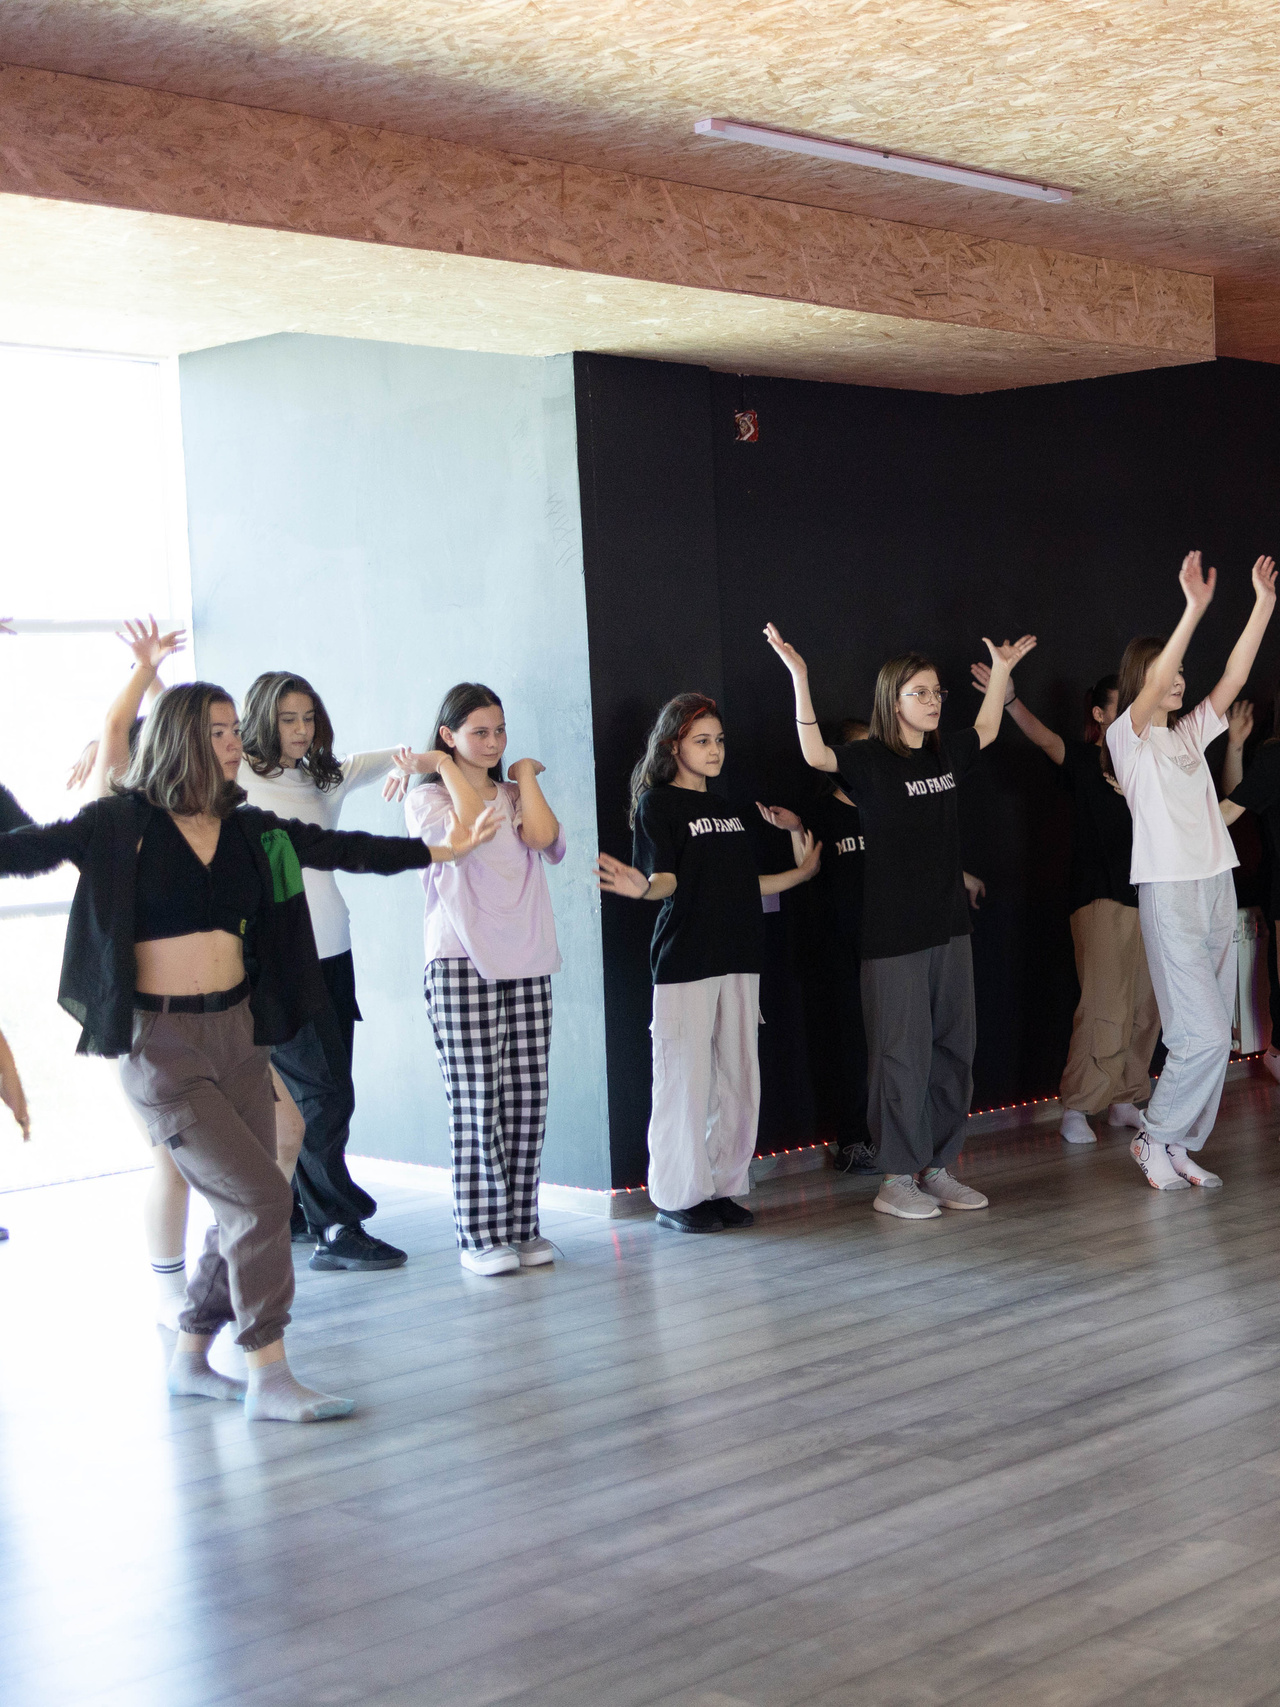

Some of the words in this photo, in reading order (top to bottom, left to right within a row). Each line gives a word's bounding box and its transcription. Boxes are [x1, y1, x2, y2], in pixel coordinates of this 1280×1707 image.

[904, 781, 927, 796] MD
[688, 818, 712, 837] MD
[712, 817, 745, 832] FAMIL
[835, 837, 856, 855] MD
